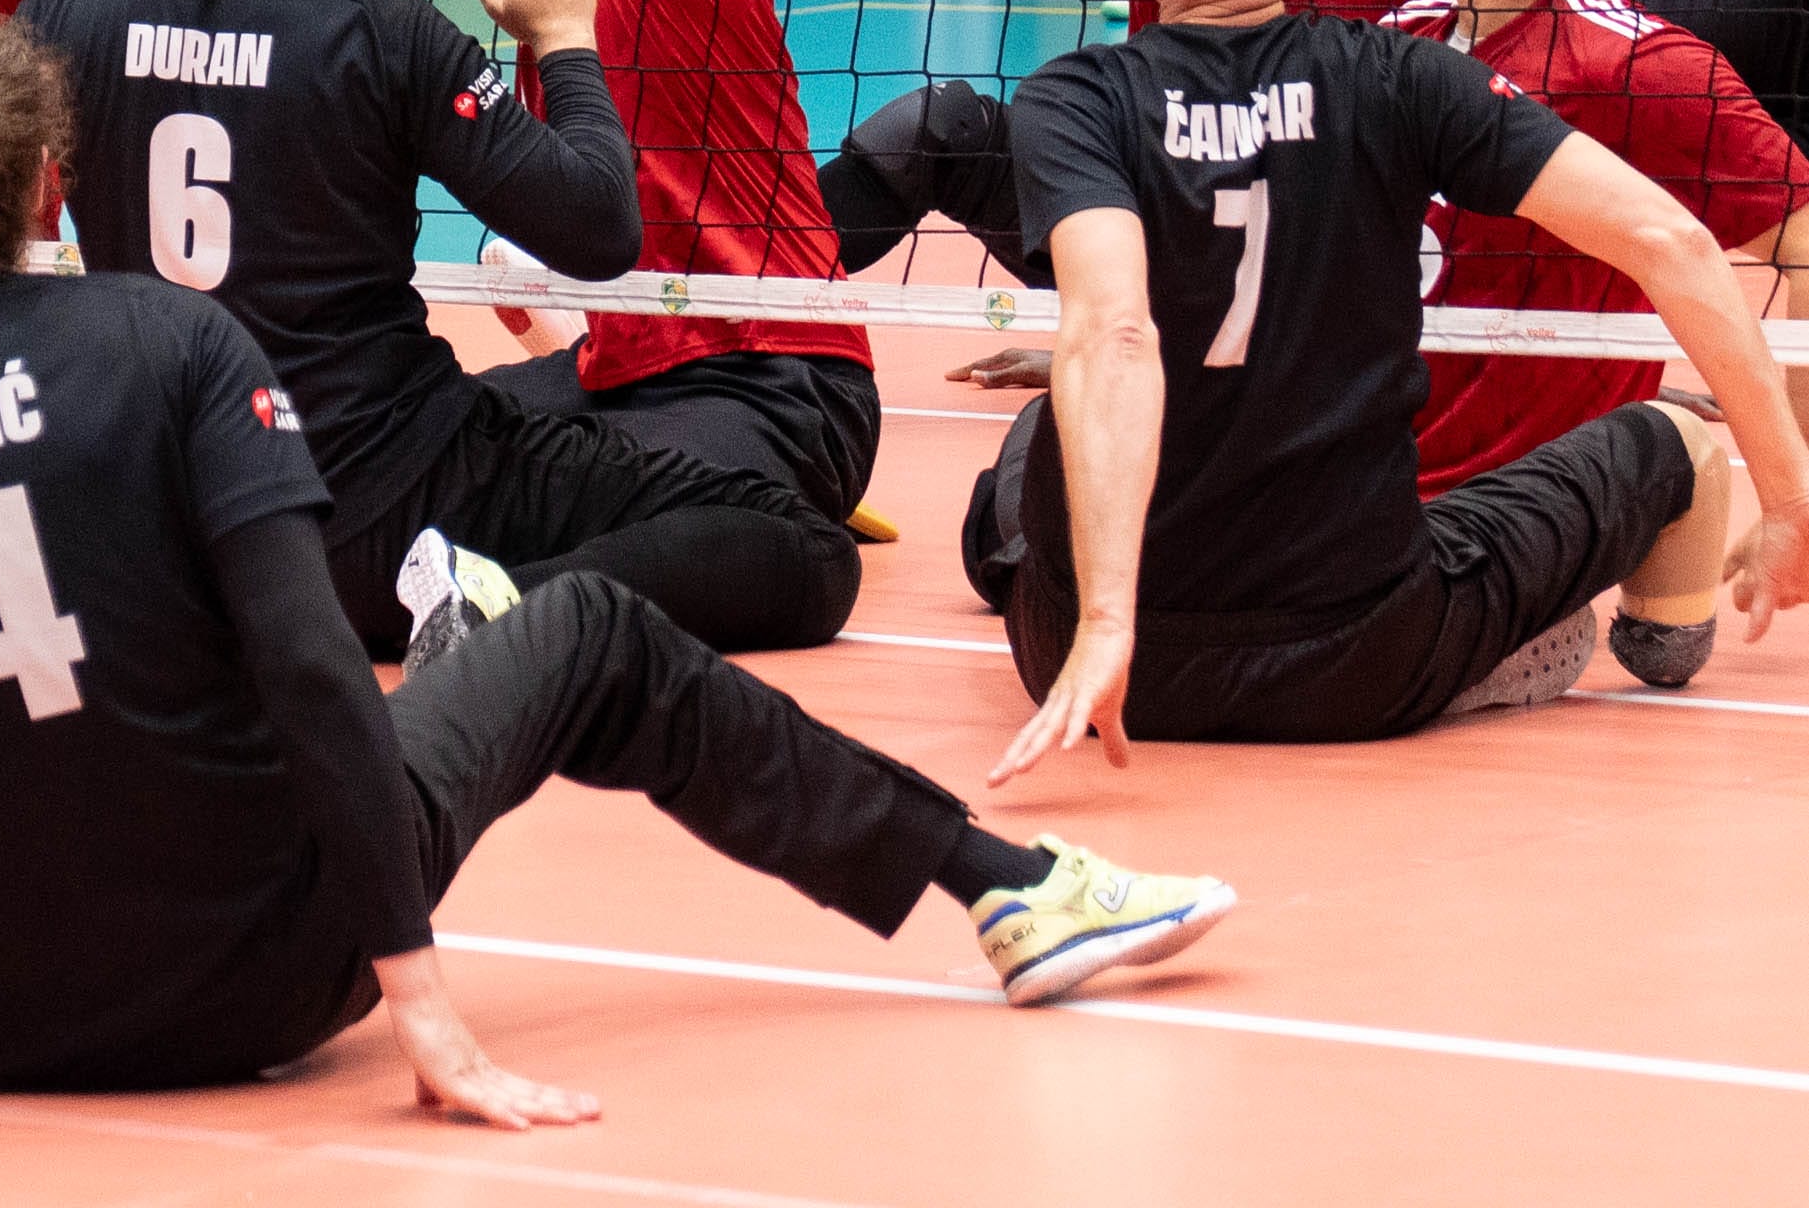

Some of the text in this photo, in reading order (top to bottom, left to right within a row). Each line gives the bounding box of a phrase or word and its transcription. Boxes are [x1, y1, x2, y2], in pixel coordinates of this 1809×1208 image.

[125, 22, 274, 88] DURAN
[148, 112, 232, 291] 6
[1203, 179, 1271, 368] 7
